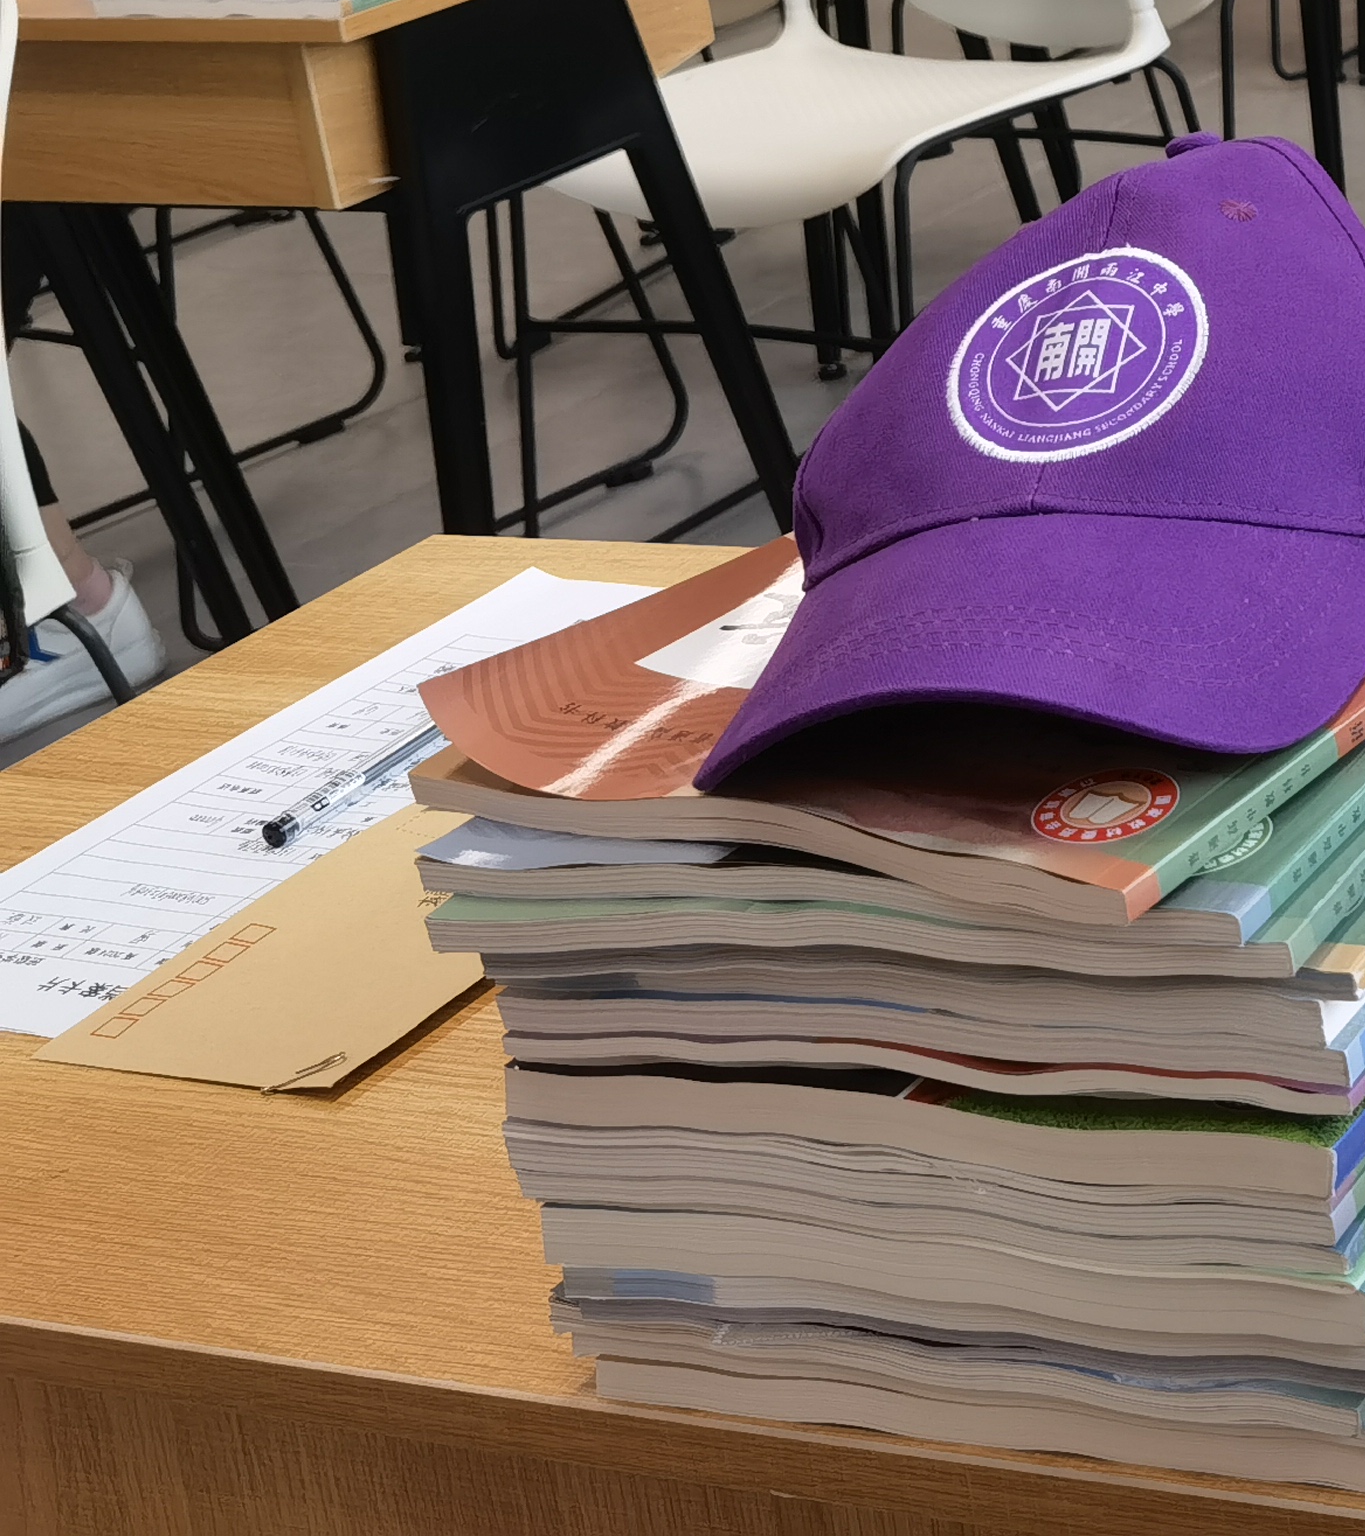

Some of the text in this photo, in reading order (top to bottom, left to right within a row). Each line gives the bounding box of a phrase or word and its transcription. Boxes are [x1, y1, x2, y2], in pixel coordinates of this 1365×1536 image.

[967, 339, 1182, 445] CHONGQING NANKAI LIANGJIANG SECONDARY SCHOOL
